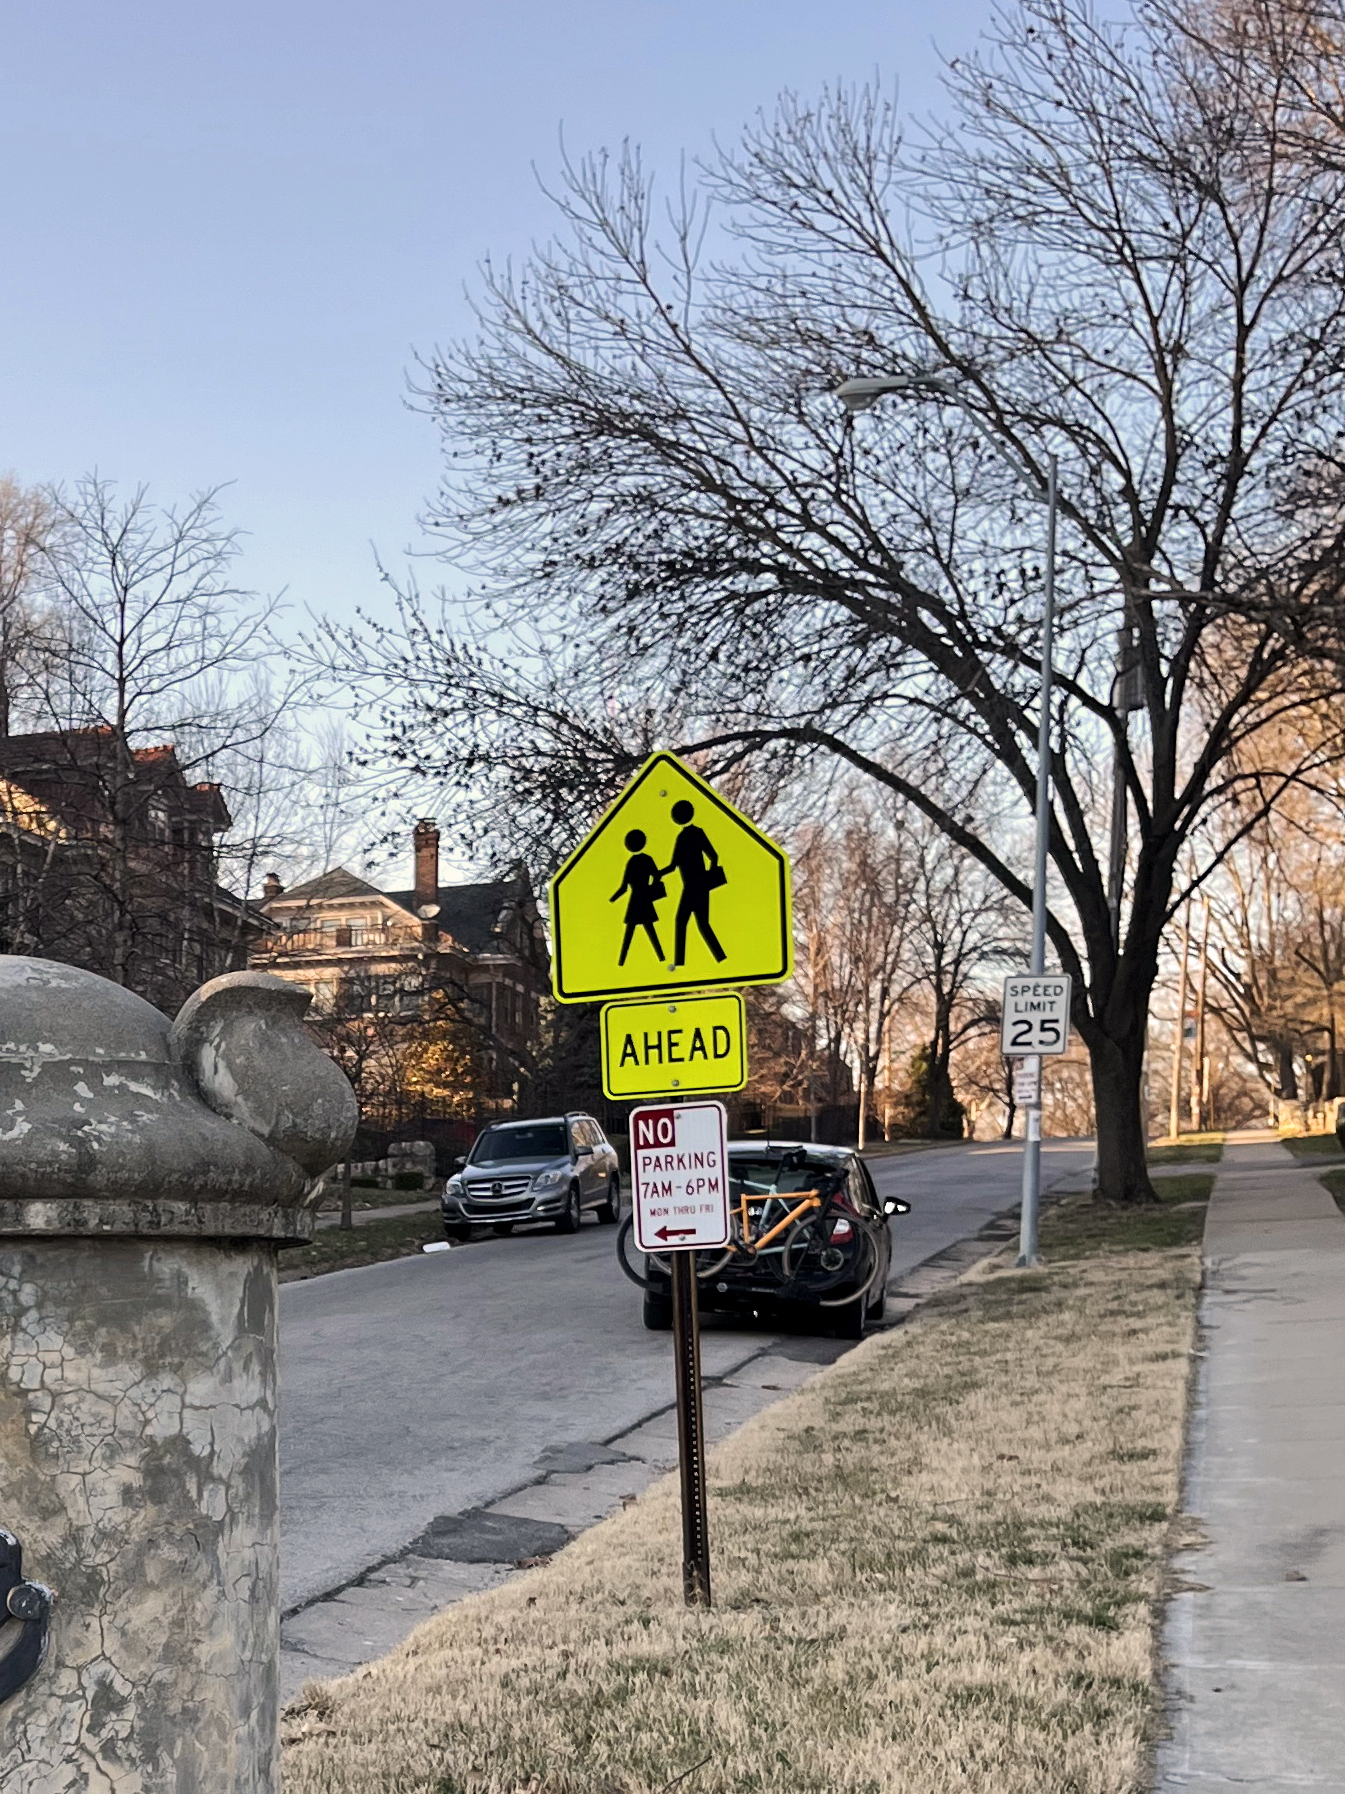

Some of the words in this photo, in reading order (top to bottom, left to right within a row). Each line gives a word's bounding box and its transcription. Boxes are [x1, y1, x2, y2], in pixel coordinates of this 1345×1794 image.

[1010, 985, 1063, 997] SPEED
[1014, 1001, 1056, 1013] LIMIT
[1010, 1019, 1060, 1046] 25
[620, 1026, 730, 1067] AHEAD
[638, 1117, 673, 1146] NO
[642, 1151, 717, 1173] PARKING
[650, 1207, 669, 1217] MON
[673, 1205, 696, 1216] THRU
[700, 1204, 714, 1214] FRI
